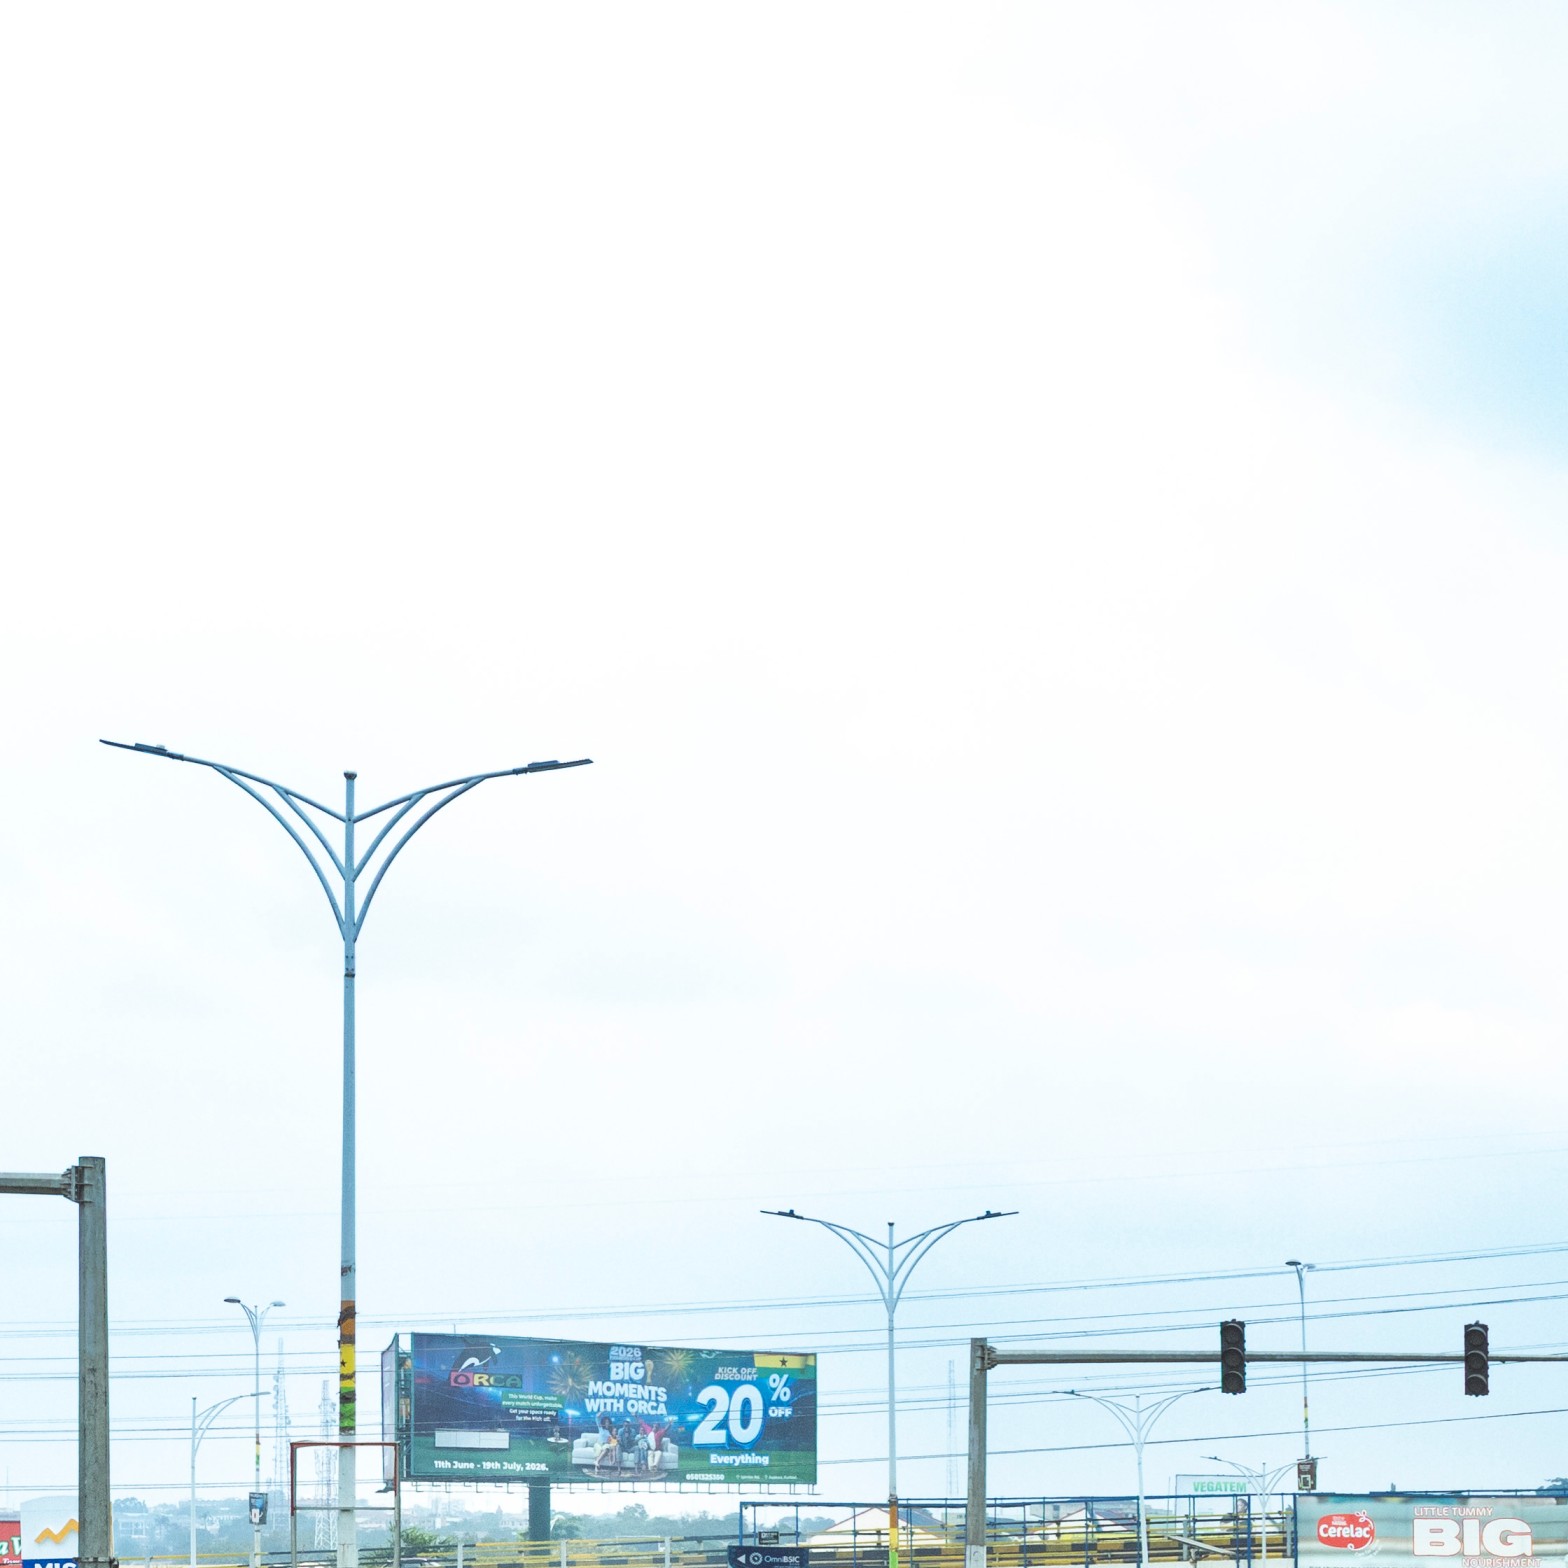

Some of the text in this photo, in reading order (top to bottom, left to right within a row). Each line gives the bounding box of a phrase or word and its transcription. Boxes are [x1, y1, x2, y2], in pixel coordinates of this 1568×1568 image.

[610, 1346, 642, 1357] 2026
[610, 1361, 645, 1381] BIG
[714, 1373, 758, 1381] DISCOUNT
[718, 1367, 757, 1375] KICK OFF
[453, 1373, 522, 1388] ORCA
[588, 1380, 667, 1401] MOMENTS
[769, 1374, 791, 1402] %
[584, 1398, 667, 1416] WITH ORCA
[768, 1406, 792, 1417] OFF
[693, 1384, 763, 1445] 20
[710, 1453, 769, 1466] Everything
[434, 1460, 549, 1472] 11th June 19th July, 2026.
[1192, 1481, 1247, 1493] VEGATEM
[1414, 1506, 1493, 1516] LITTLE TUMMY
[1319, 1524, 1371, 1538] Cerelac
[1413, 1518, 1533, 1557] BIG
[764, 1555, 800, 1564] OmniBSIC
[1462, 1558, 1543, 1568] NOURISHMENT
